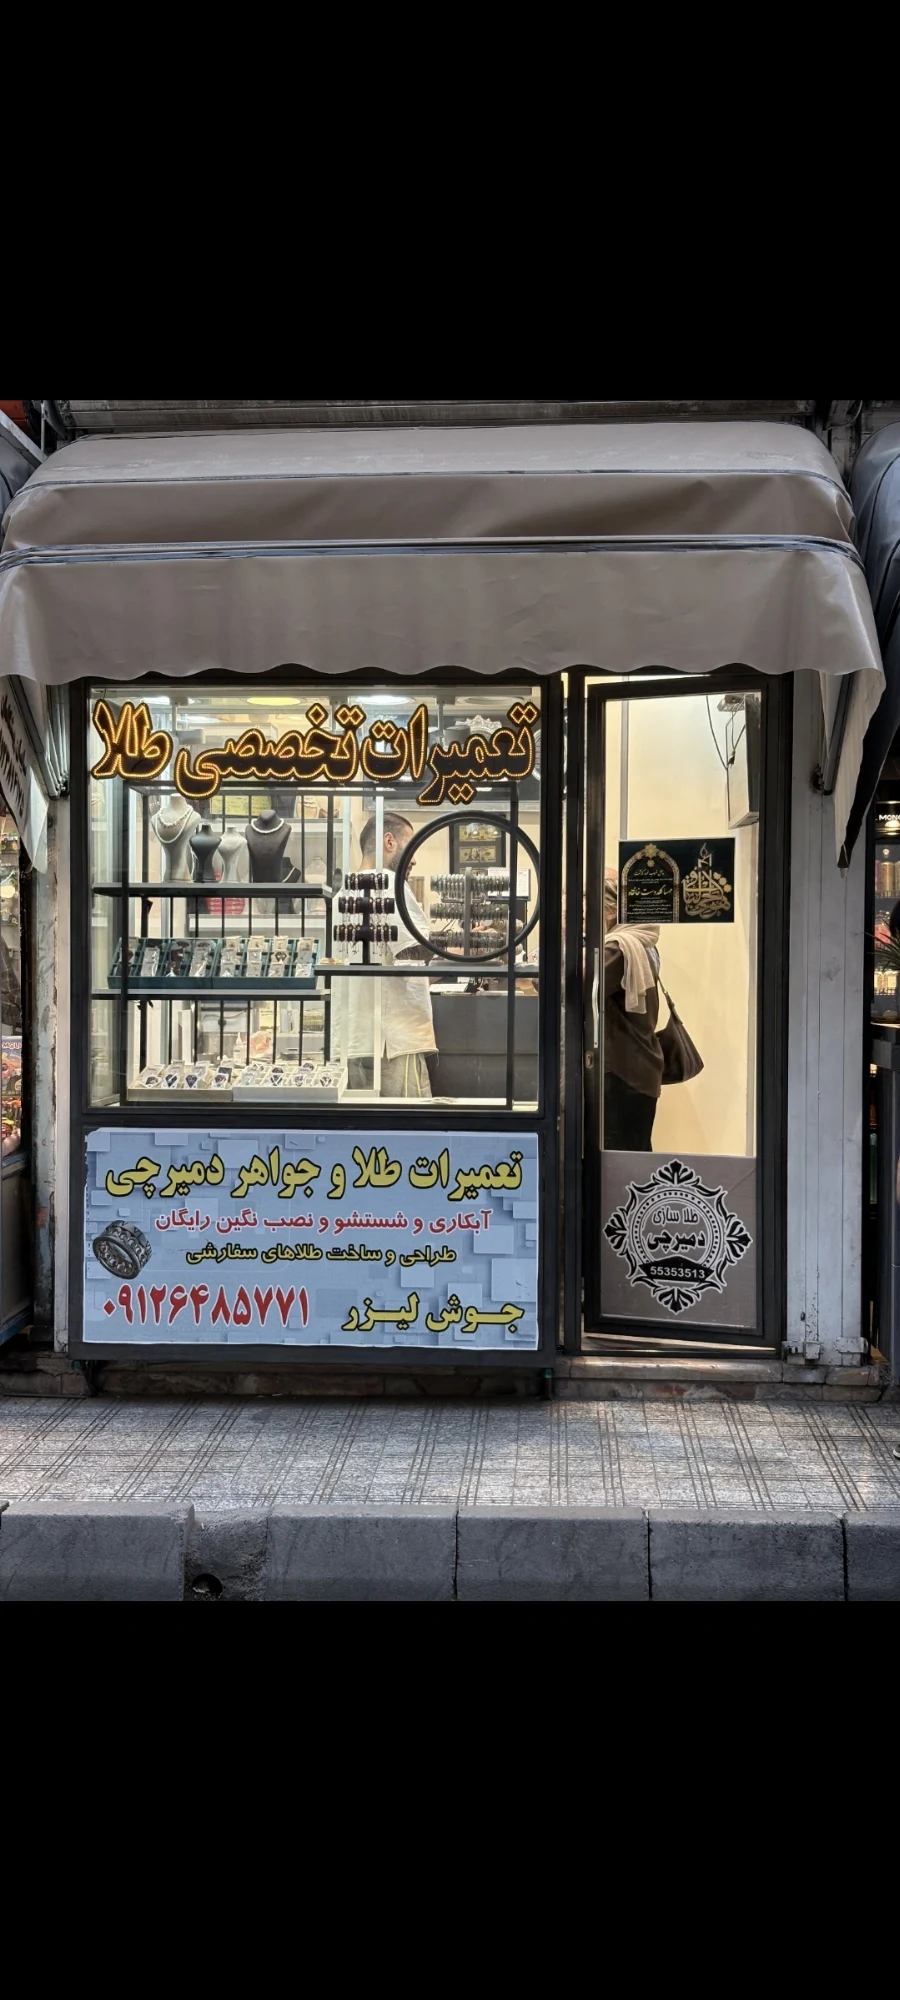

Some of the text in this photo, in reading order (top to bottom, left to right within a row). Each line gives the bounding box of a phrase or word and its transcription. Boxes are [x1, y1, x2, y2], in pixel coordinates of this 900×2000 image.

[93, 700, 173, 780] طلا
[174, 702, 366, 800] تخصصی
[361, 703, 541, 804] تعمیرات
[105, 1146, 524, 1201] تعمیرات طلا و جواهر دمیرچی
[155, 1207, 493, 1234] آبکاری و شستشو و نصب نگین رایگان
[652, 1206, 699, 1226] طلا سازی
[186, 1243, 457, 1267] طراحی و ساخت طلاهای سفارشی
[647, 1230, 706, 1253] دمیرچی
[650, 1267, 705, 1279] 55353513
[103, 1284, 309, 1327] ۰۹۱۲۶۴۸۵۷۷۱
[341, 1292, 525, 1334] جوش لیزر
